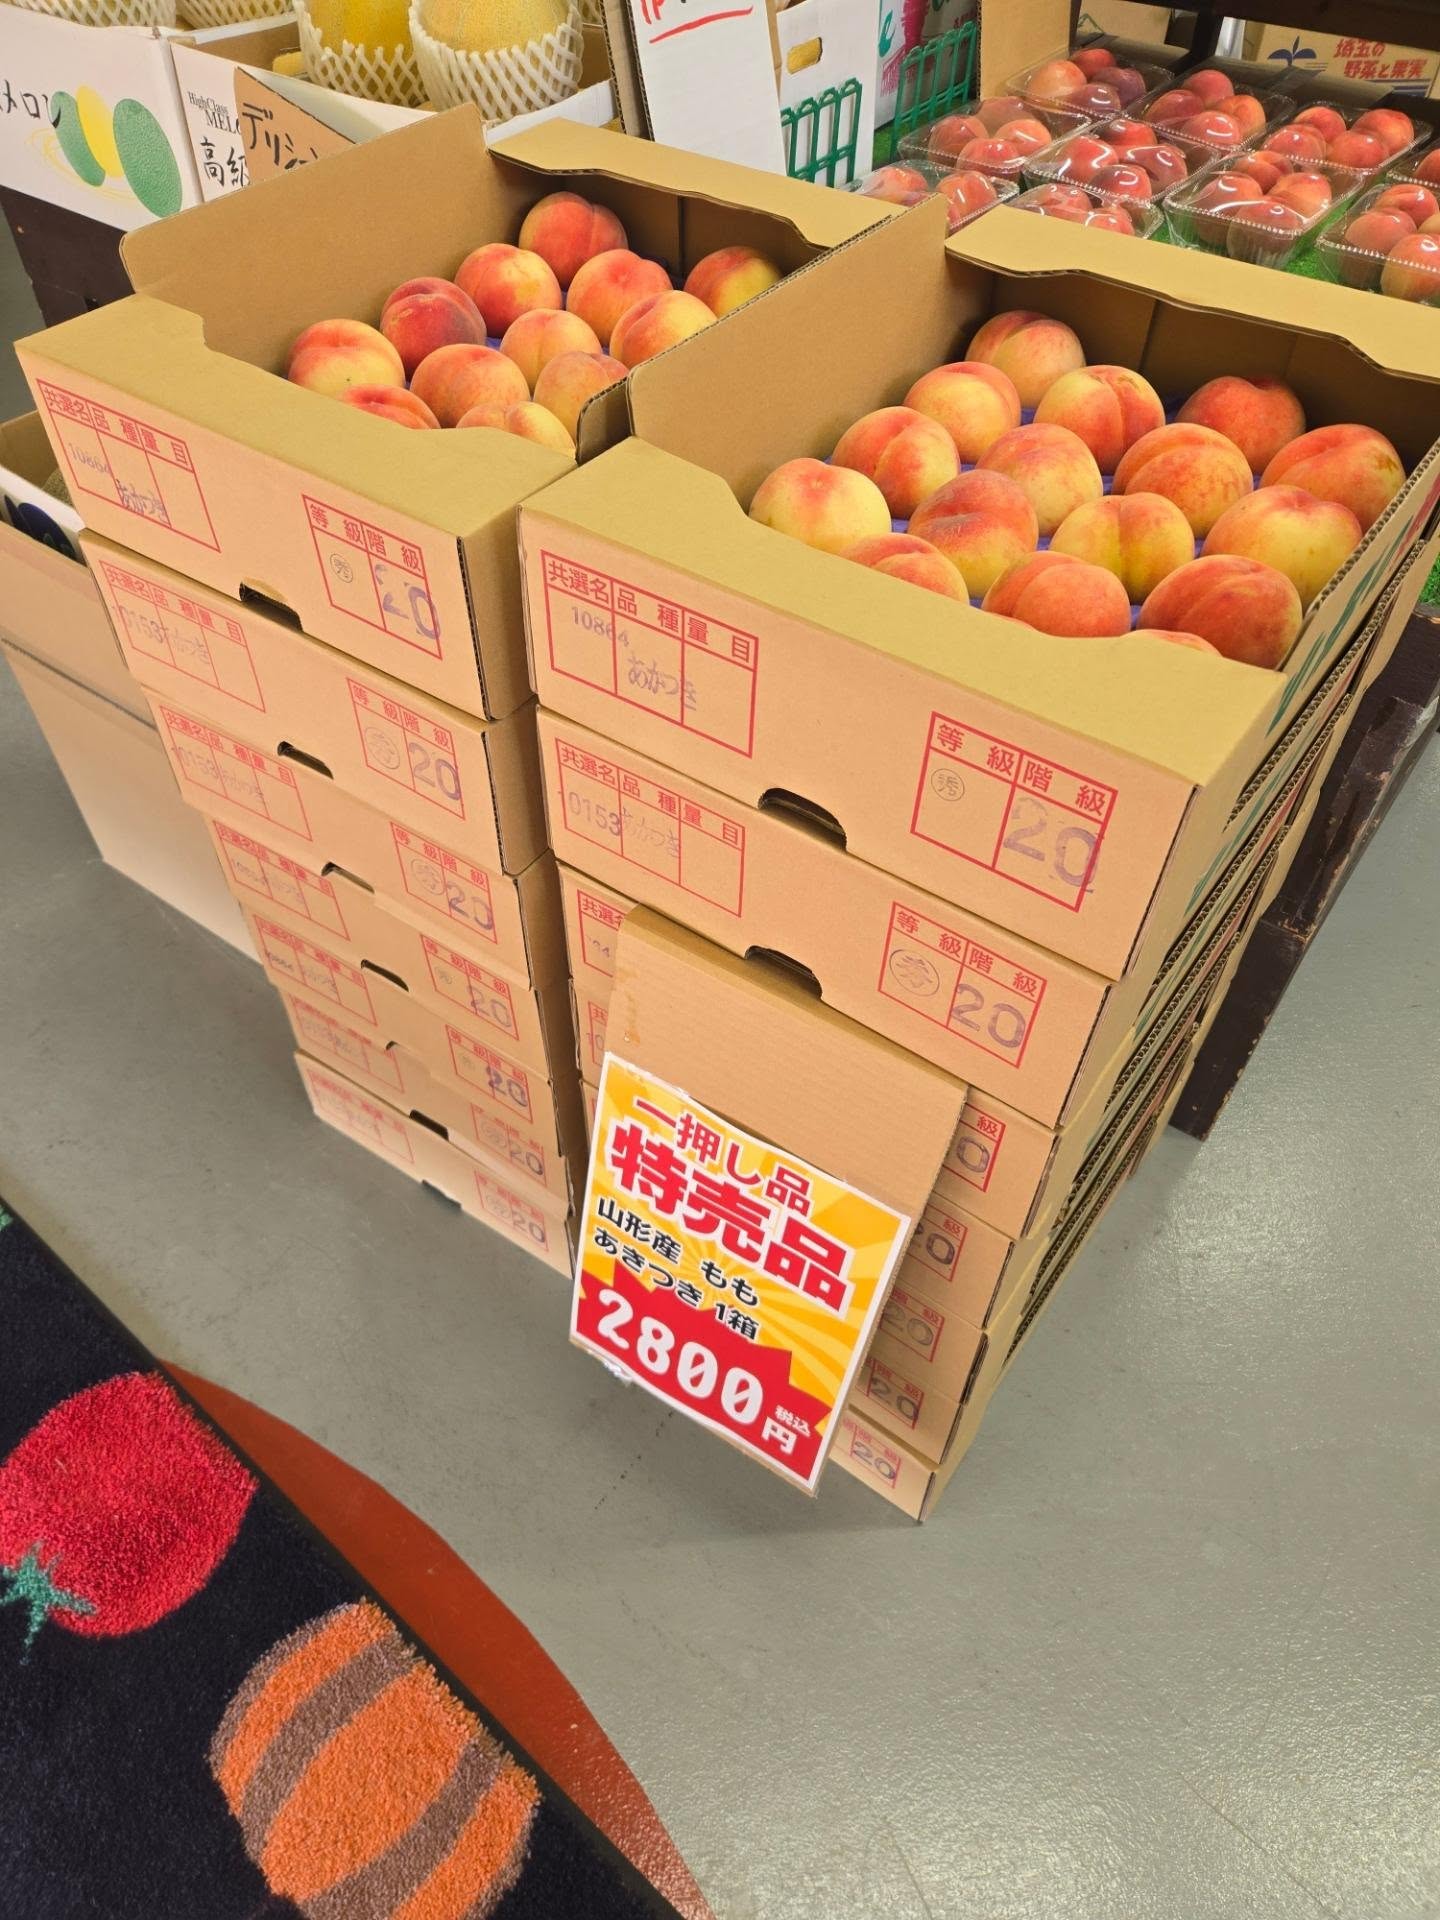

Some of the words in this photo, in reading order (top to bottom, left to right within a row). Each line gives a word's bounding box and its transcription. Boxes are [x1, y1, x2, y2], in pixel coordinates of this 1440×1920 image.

[1334, 38, 1386, 58] 埼玉の
[1344, 59, 1428, 80] 野菜と果実
[205, 110, 241, 135] MEL
[374, 564, 441, 640] 20
[548, 560, 610, 604] 共選名
[616, 588, 679, 633] 品種
[688, 617, 750, 663] 量目
[571, 606, 630, 647] 10864
[408, 742, 462, 801] 20
[561, 746, 616, 786] 共選名
[622, 773, 677, 815] 品種
[684, 803, 738, 846] 量目
[936, 723, 1015, 776] 等級
[1023, 760, 1107, 816] 階級
[1003, 797, 1099, 888] 20
[446, 881, 494, 930] 20
[896, 910, 962, 959] 等級
[969, 947, 1038, 998] 階級
[951, 983, 1027, 1049] 20
[486, 1066, 528, 1108] 20
[636, 1098, 810, 1217] 一押し品
[611, 1123, 848, 1312] 特売品
[597, 1197, 681, 1265] 山形産
[700, 1260, 758, 1307] もも
[594, 1227, 703, 1308] あきつき
[715, 1302, 759, 1340] 1箱
[882, 1303, 935, 1346] 20
[774, 1404, 811, 1438] 税込
[870, 1376, 920, 1421] 20
[852, 1440, 897, 1480] 20
